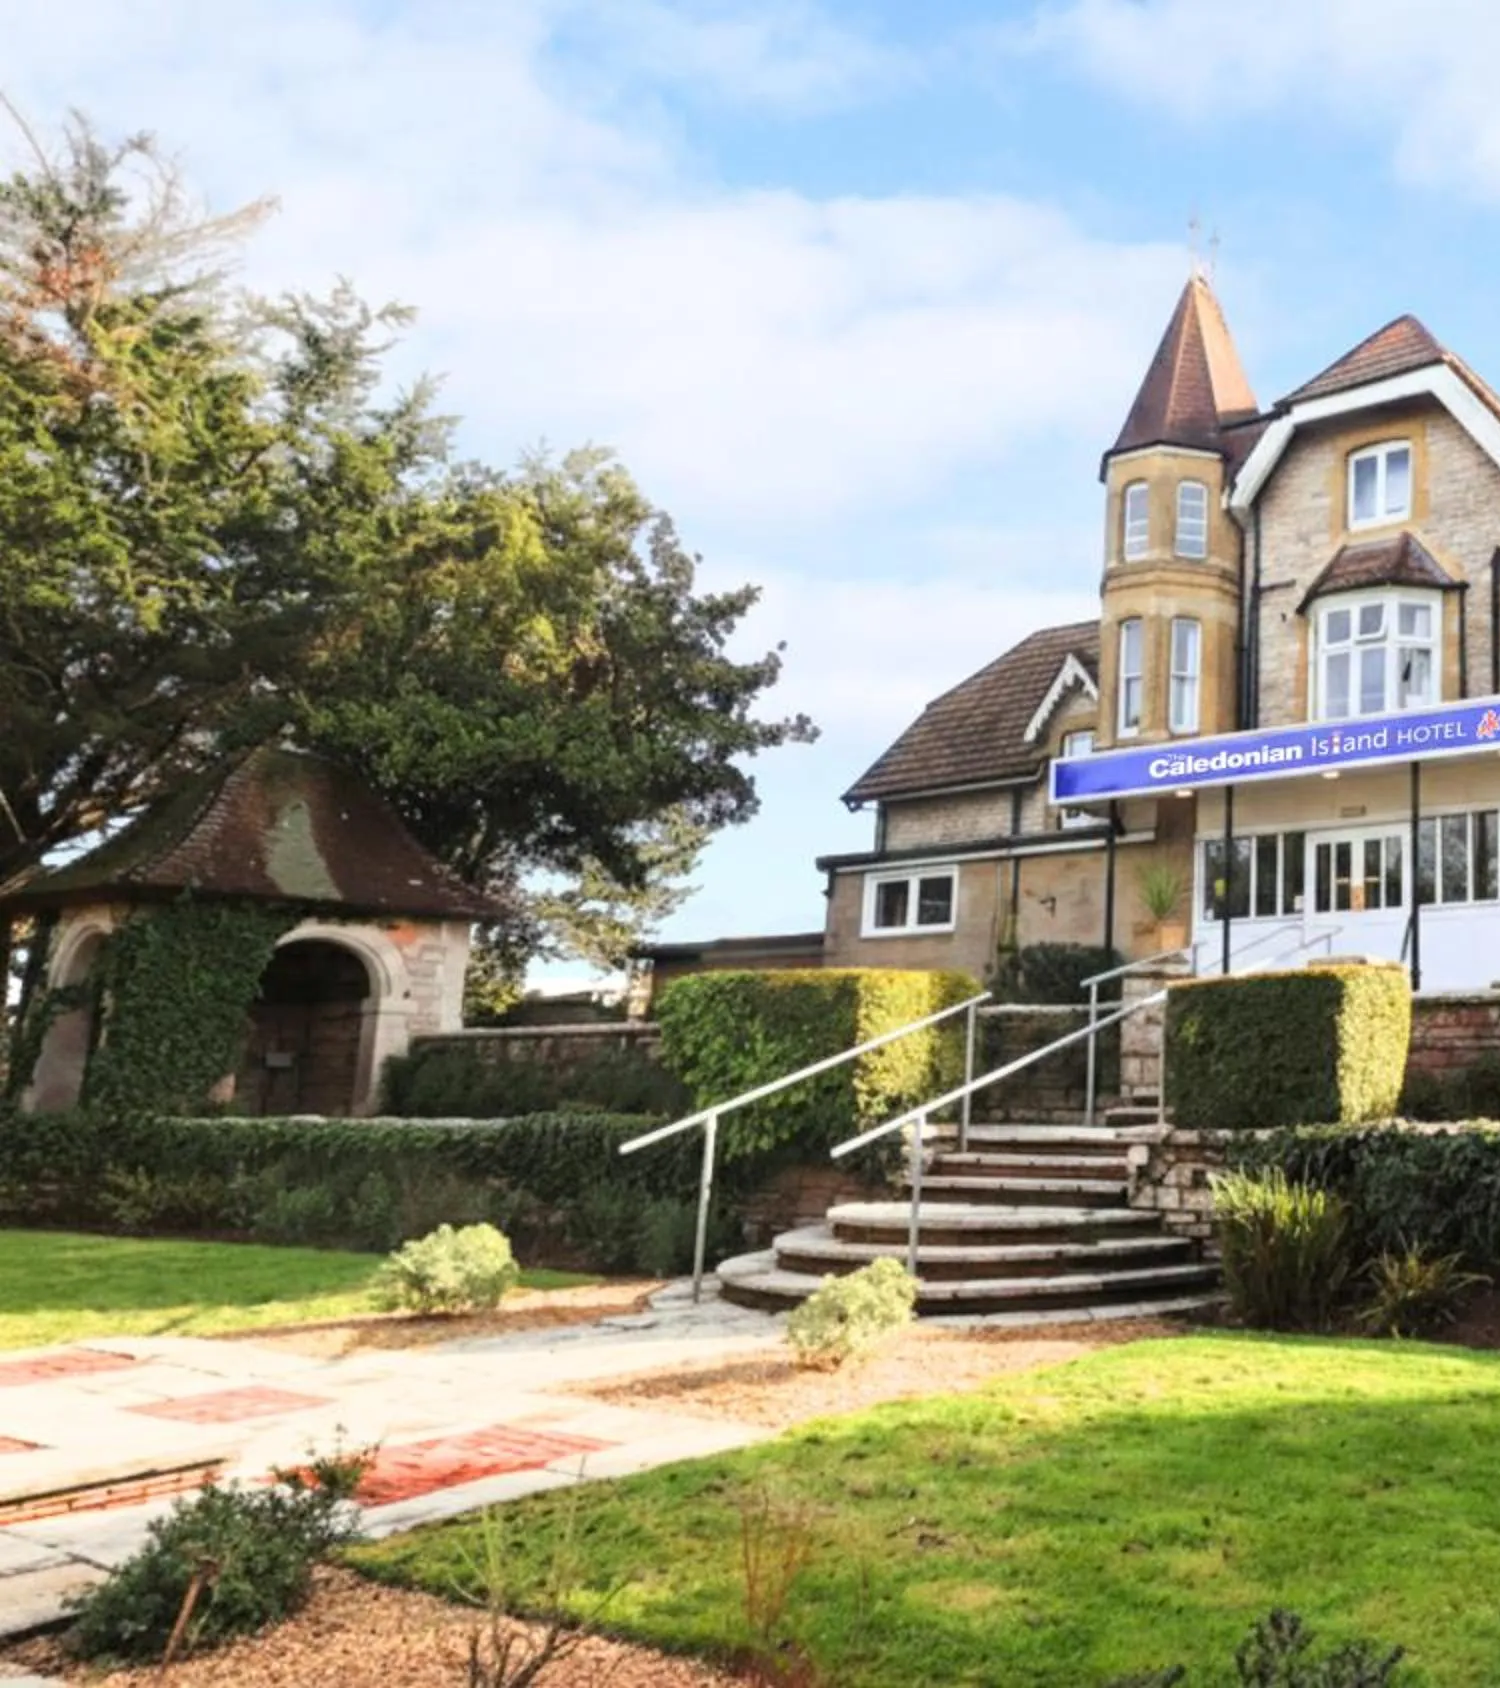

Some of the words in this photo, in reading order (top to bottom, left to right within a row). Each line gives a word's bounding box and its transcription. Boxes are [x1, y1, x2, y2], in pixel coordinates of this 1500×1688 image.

[1149, 745, 1303, 779] Caledonian
[1311, 728, 1388, 756] Island
[1396, 721, 1468, 745] HOTEL
